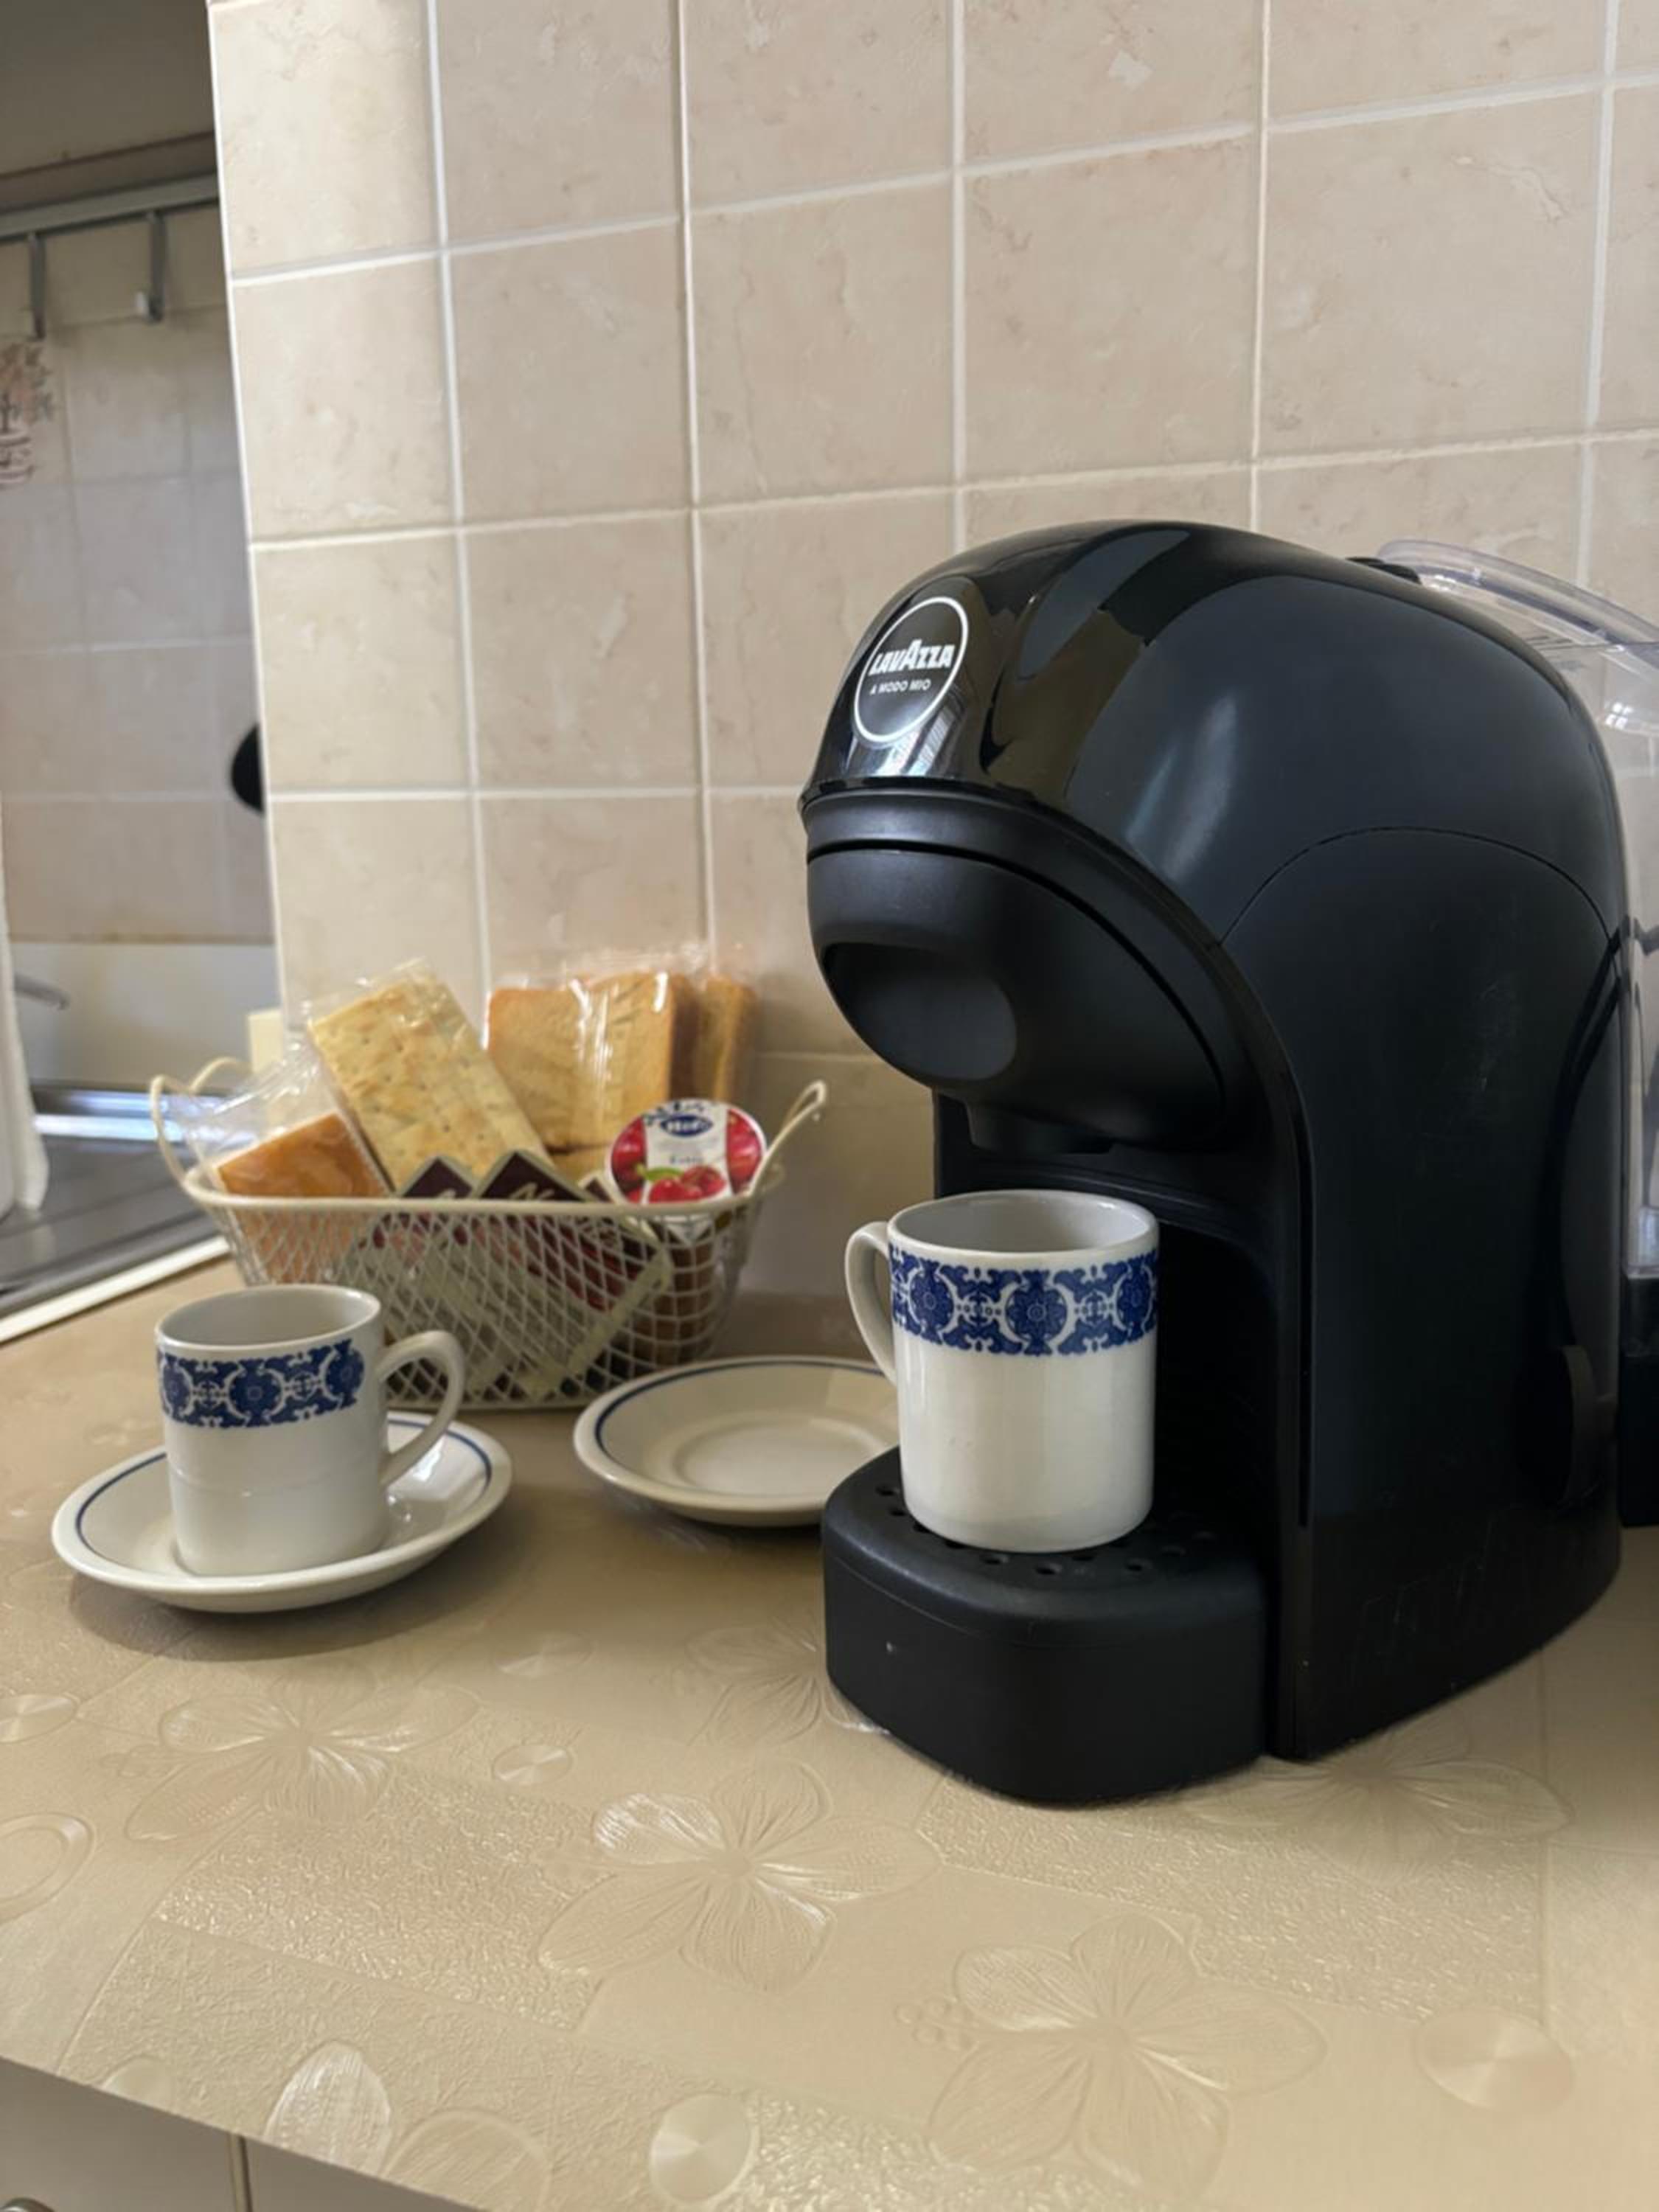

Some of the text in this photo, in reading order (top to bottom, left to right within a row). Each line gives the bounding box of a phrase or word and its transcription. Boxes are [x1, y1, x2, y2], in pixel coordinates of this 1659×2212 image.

[869, 639, 955, 675] LAVAZZA
[878, 681, 908, 693] MODO
[909, 679, 931, 692] MIO
